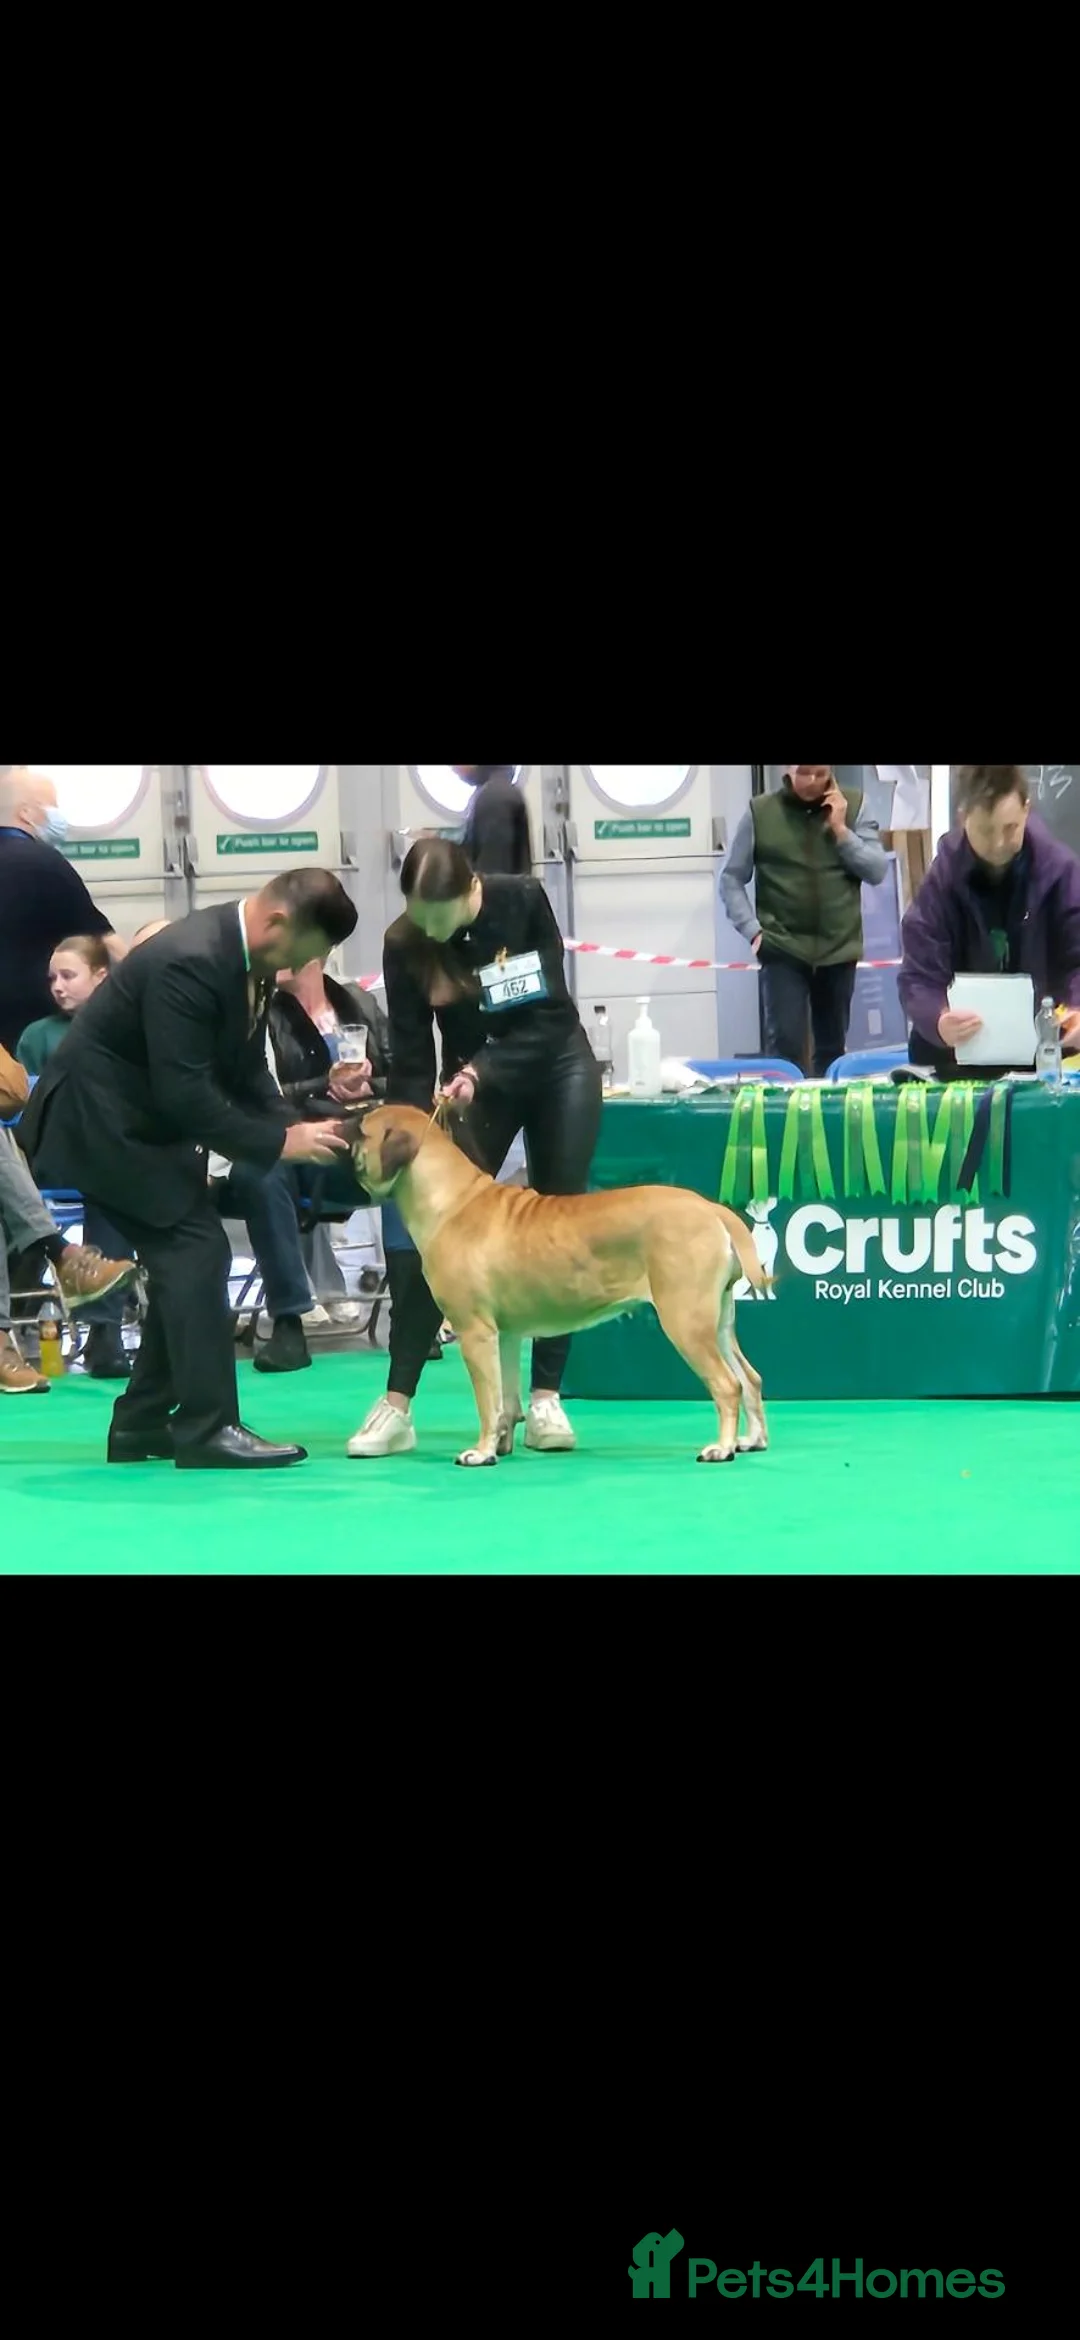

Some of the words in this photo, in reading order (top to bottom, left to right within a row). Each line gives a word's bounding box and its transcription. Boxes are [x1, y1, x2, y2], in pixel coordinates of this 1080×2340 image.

[785, 1203, 1037, 1276] Crufts
[815, 1279, 871, 1304] Royal
[878, 1279, 952, 1300] Kennel
[957, 1279, 1005, 1300] Club
